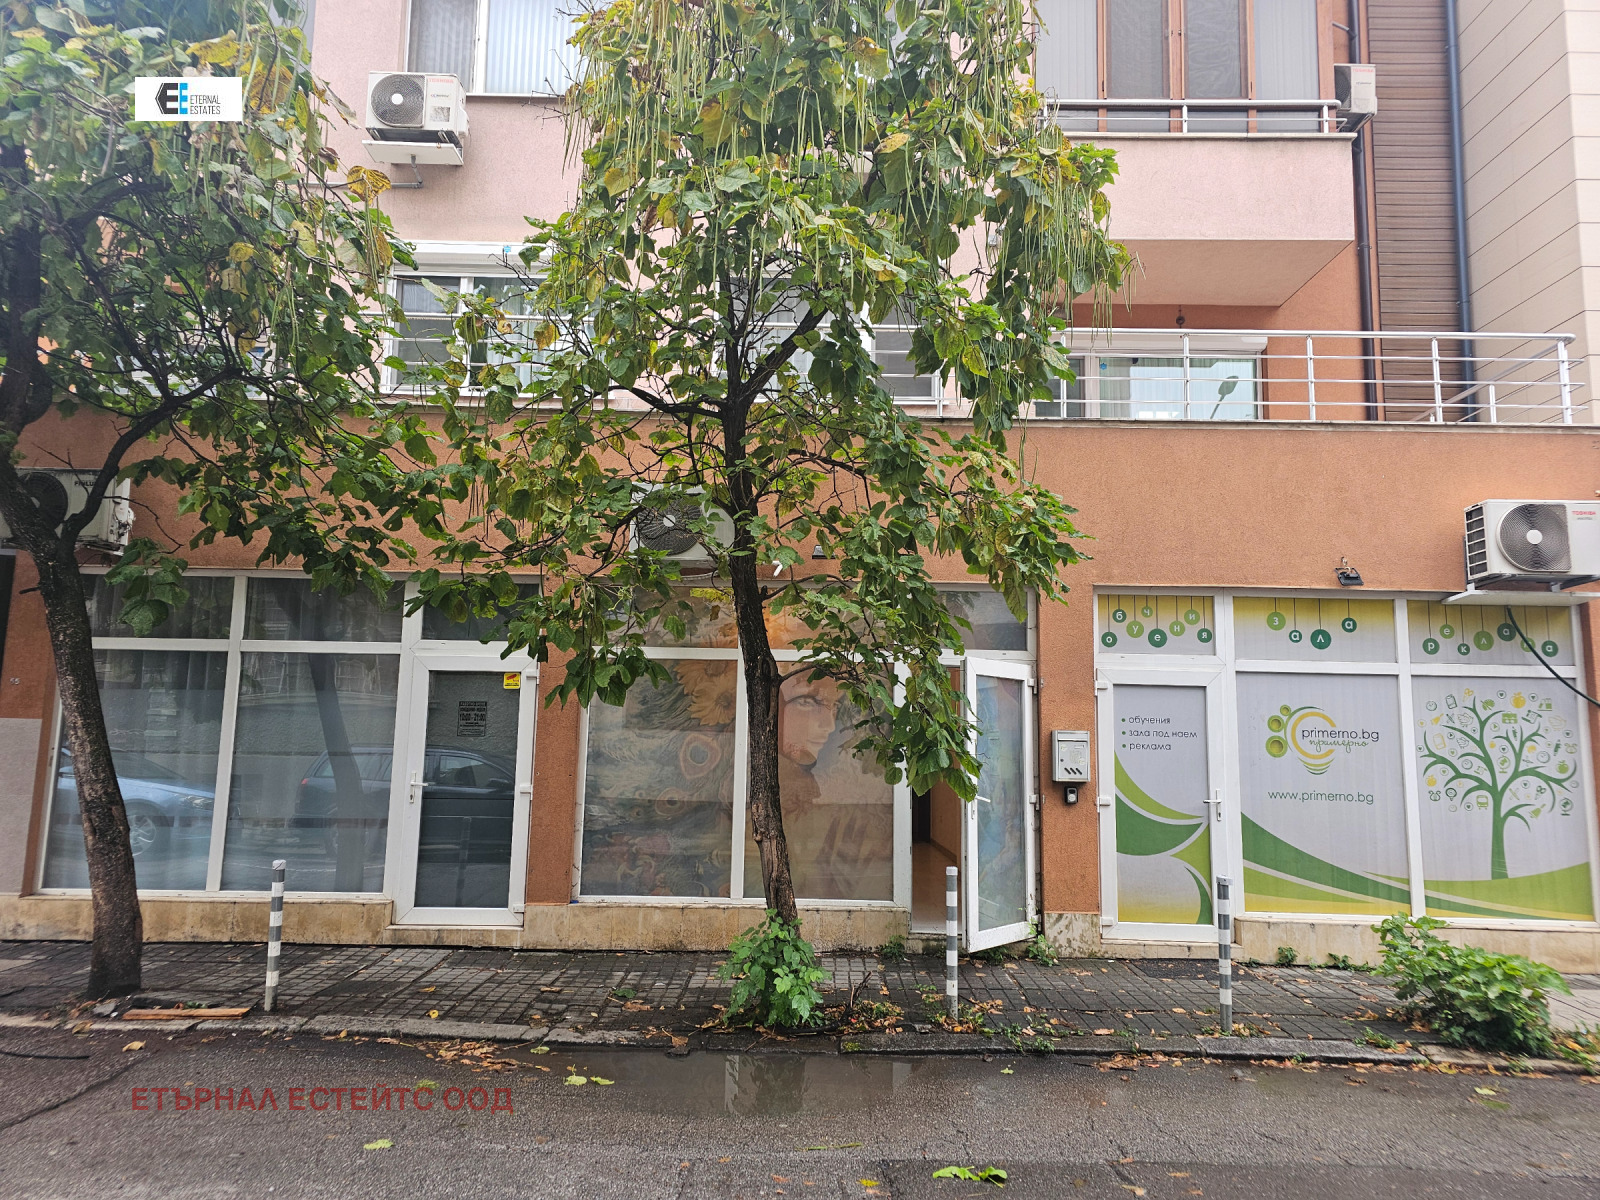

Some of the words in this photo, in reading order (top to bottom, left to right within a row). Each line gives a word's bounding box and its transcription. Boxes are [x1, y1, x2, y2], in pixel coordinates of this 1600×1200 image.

[1128, 715, 1171, 725] обучения
[1152, 730, 1170, 738] под
[1171, 730, 1198, 738] наем
[1301, 729, 1380, 745] primerno.bg
[1129, 743, 1172, 751] реклама
[1267, 791, 1375, 807] www.primerno.bg
